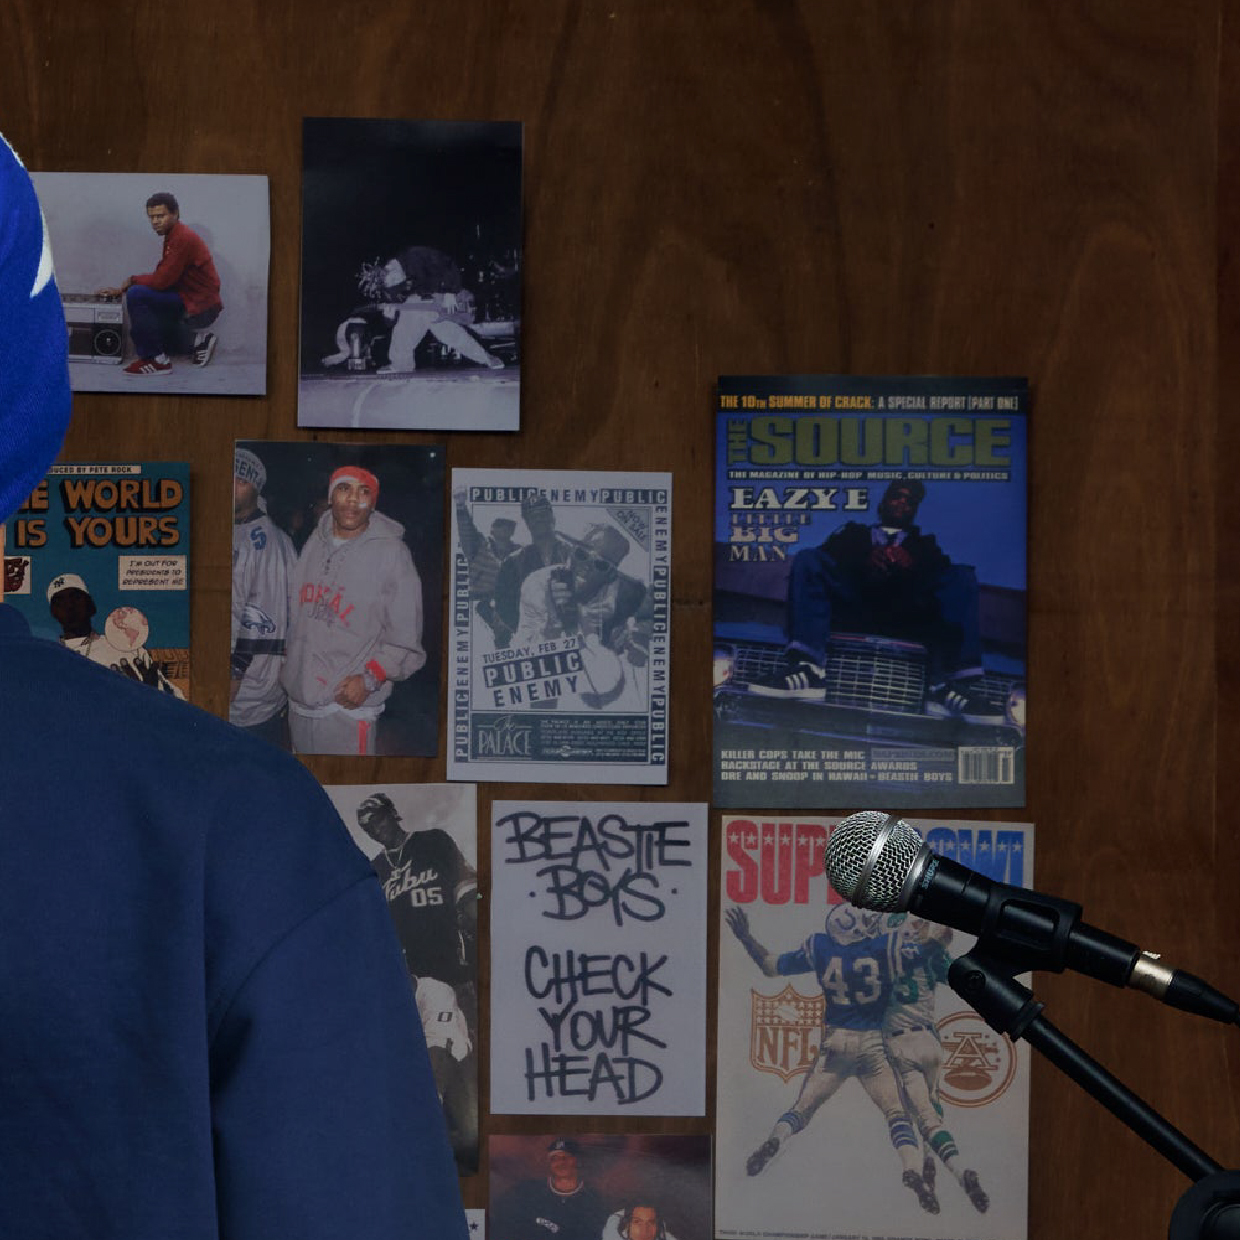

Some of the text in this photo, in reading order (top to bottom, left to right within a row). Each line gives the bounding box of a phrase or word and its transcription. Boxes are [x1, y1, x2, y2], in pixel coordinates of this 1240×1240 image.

[721, 395, 738, 409] THE
[768, 395, 816, 409] SUMMER
[819, 395, 832, 409] OF
[835, 395, 874, 409] CRACK:
[878, 395, 885, 410] A
[887, 395, 926, 410] SPECIAL
[929, 395, 966, 410] REPORT
[728, 418, 748, 466] THE
[750, 415, 1011, 466] SOURCE
[76, 466, 87, 474] BY
[89, 466, 109, 474] PETE
[111, 466, 133, 474] ROCK
[728, 471, 748, 479] THE
[749, 471, 800, 479] MAGAZINE
[803, 471, 816, 479] OF
[818, 471, 863, 479] HIP-HOP
[908, 471, 952, 480] CULTURE
[963, 471, 1008, 480] POLITICS
[22, 478, 183, 512] E WORLD
[472, 488, 668, 504] PUBLIC ENEMY PUBLIC
[730, 488, 869, 510] EAZY E
[15, 516, 180, 549] IS YOURS
[730, 527, 799, 542] BIG
[729, 545, 786, 562] MAN
[538, 642, 557, 654] FEB
[563, 638, 576, 649] 27
[651, 505, 668, 762] ENEMY PUBLIC ENEMY PUBLIC
[456, 627, 469, 687] ENEMY
[485, 652, 581, 688] PUBLIC
[493, 675, 577, 707] ENEMY
[455, 691, 469, 758] PUBLIC
[478, 730, 531, 755] PALACE
[721, 750, 755, 760] KILLER
[758, 750, 789, 760] COPS
[792, 750, 817, 760] TAKE
[820, 750, 840, 760] THE
[843, 750, 866, 760] MIC
[721, 761, 918, 770] BACKSTAGE AT THE SOURCE AWARDS
[721, 772, 742, 781] DRE
[745, 772, 768, 781] AND
[771, 772, 809, 781] SNOOP
[812, 772, 824, 781] IN
[877, 772, 919, 781] BEASTIE
[923, 772, 952, 781] BOYS
[496, 811, 692, 873] BEASTIE
[411, 886, 444, 908] 05
[524, 945, 673, 1006] CHECK
[821, 957, 882, 1006] 43
[537, 998, 667, 1056] YOUR
[756, 1026, 820, 1071] NFL
[524, 1042, 664, 1105] HEAD
